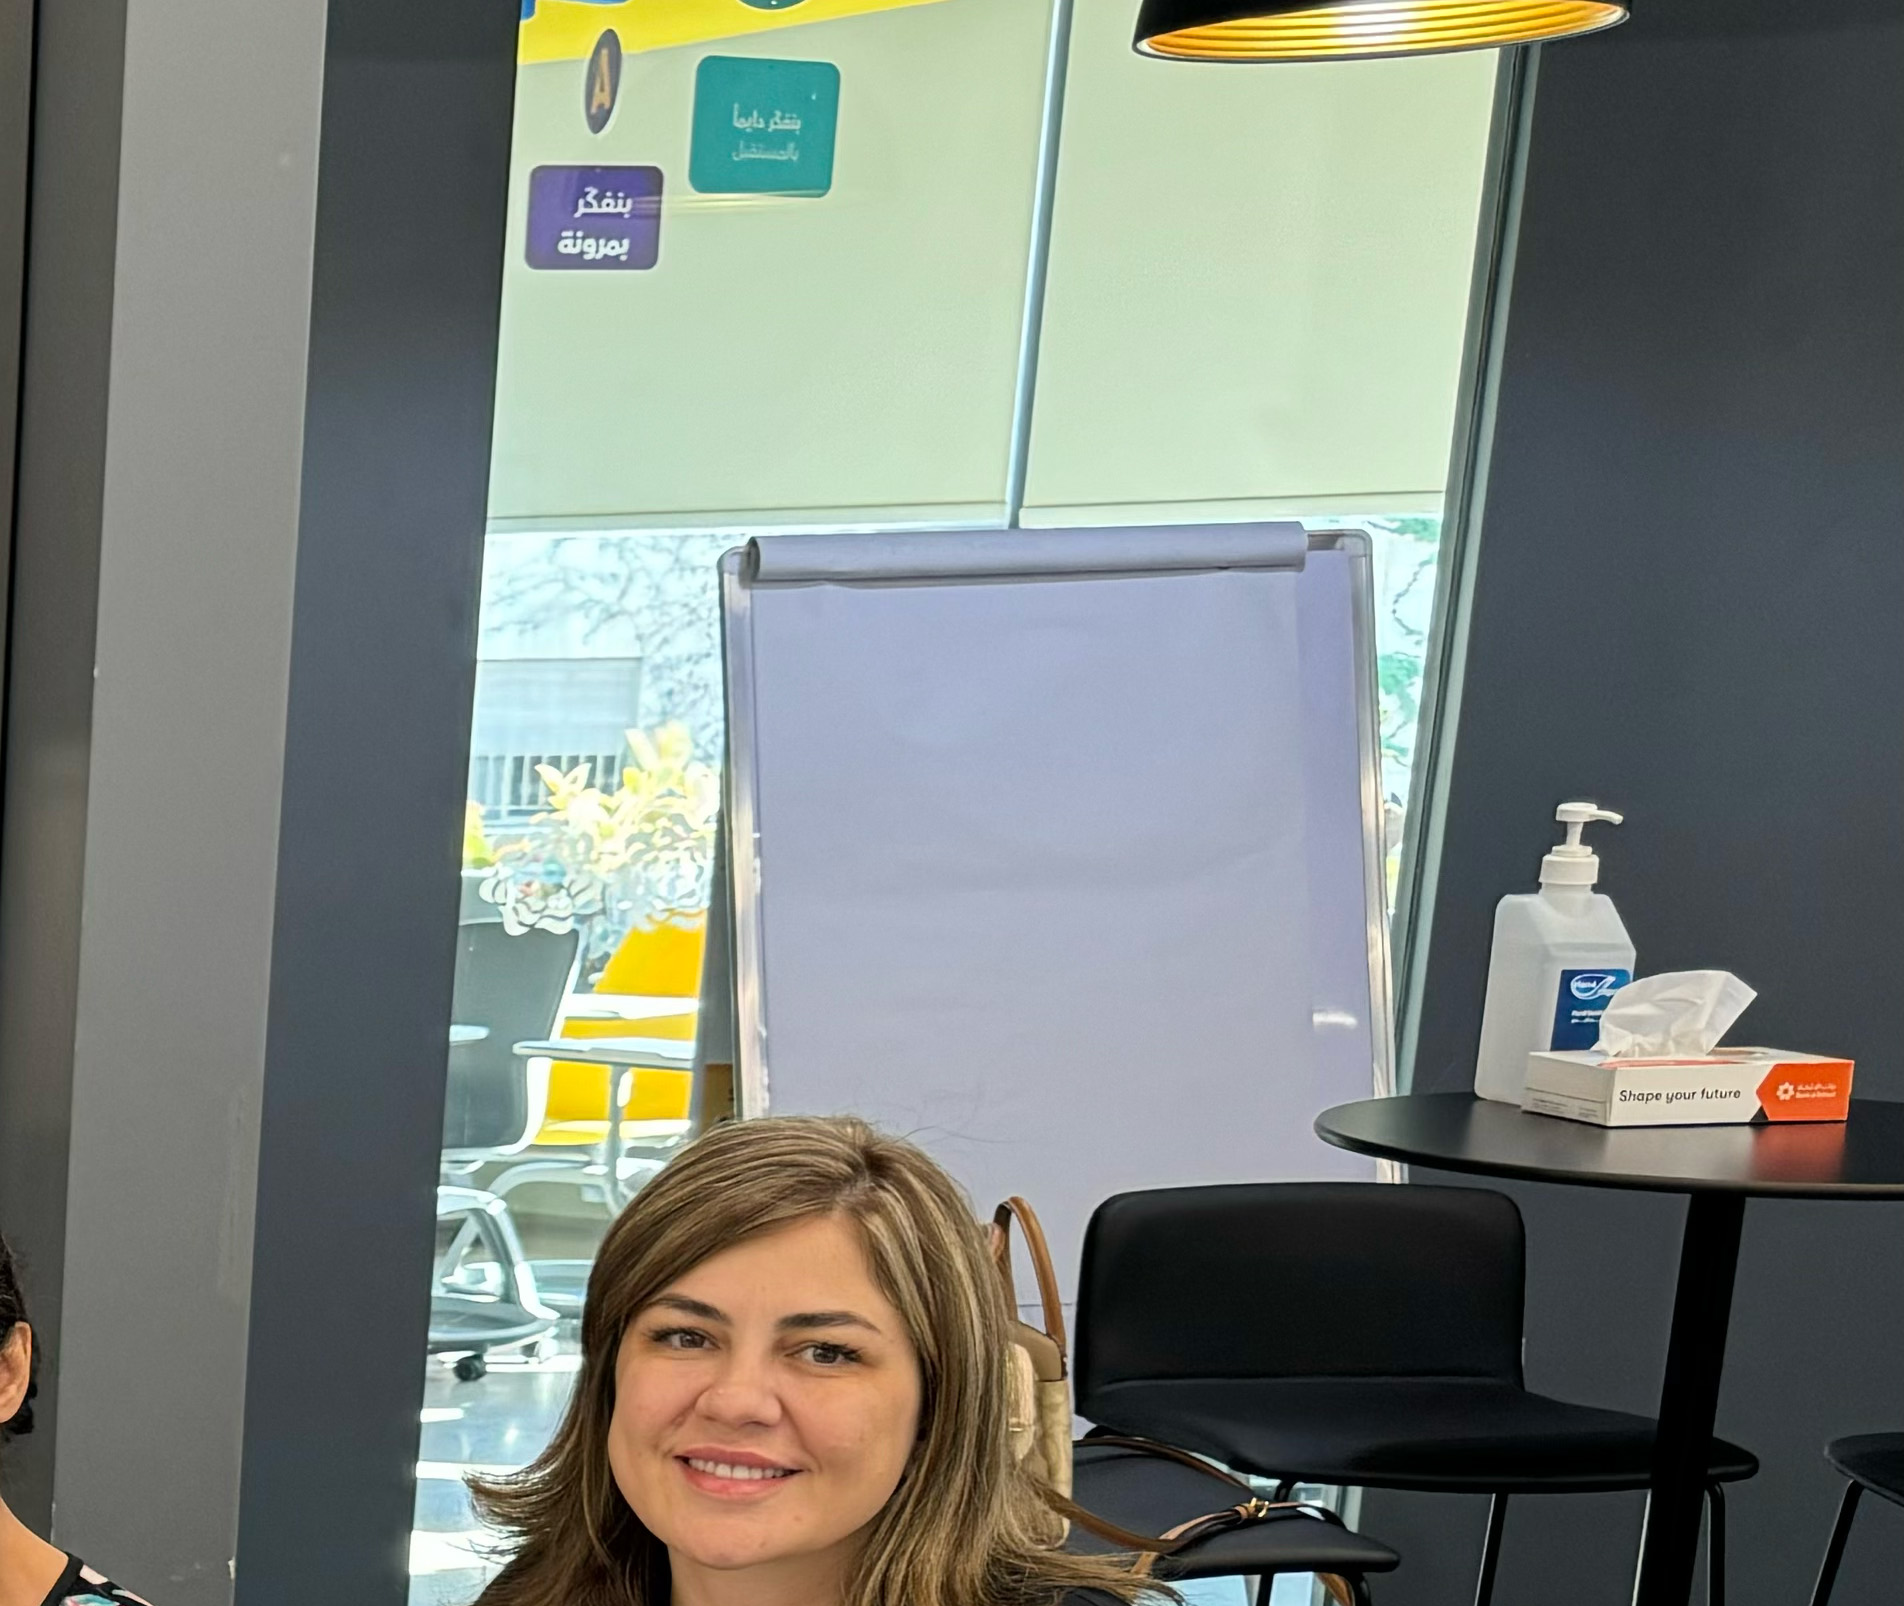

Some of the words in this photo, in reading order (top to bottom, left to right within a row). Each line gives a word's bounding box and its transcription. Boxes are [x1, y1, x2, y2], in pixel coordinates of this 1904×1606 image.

[557, 230, 630, 262] بمرونة
[1619, 1089, 1662, 1104] Shape
[1666, 1090, 1697, 1104] your
[1700, 1087, 1741, 1100] future
